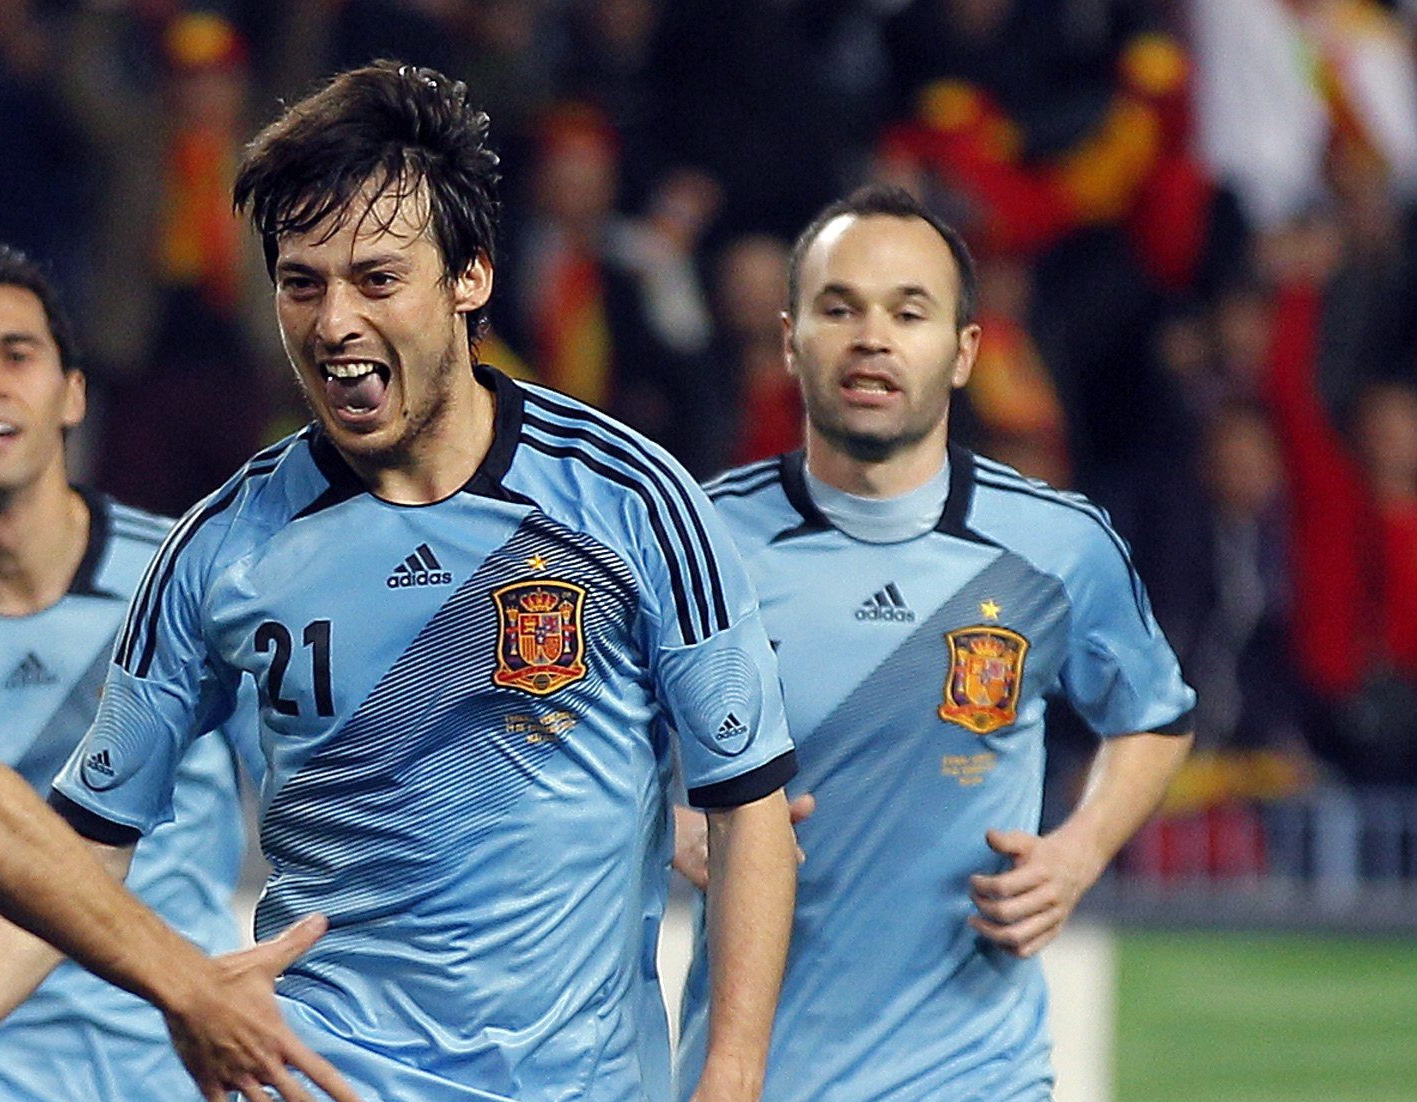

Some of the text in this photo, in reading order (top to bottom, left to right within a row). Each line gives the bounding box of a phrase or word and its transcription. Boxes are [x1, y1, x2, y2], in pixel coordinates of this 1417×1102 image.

[387, 572, 453, 588] adidas
[854, 605, 916, 623] adidas
[253, 618, 336, 718] 21
